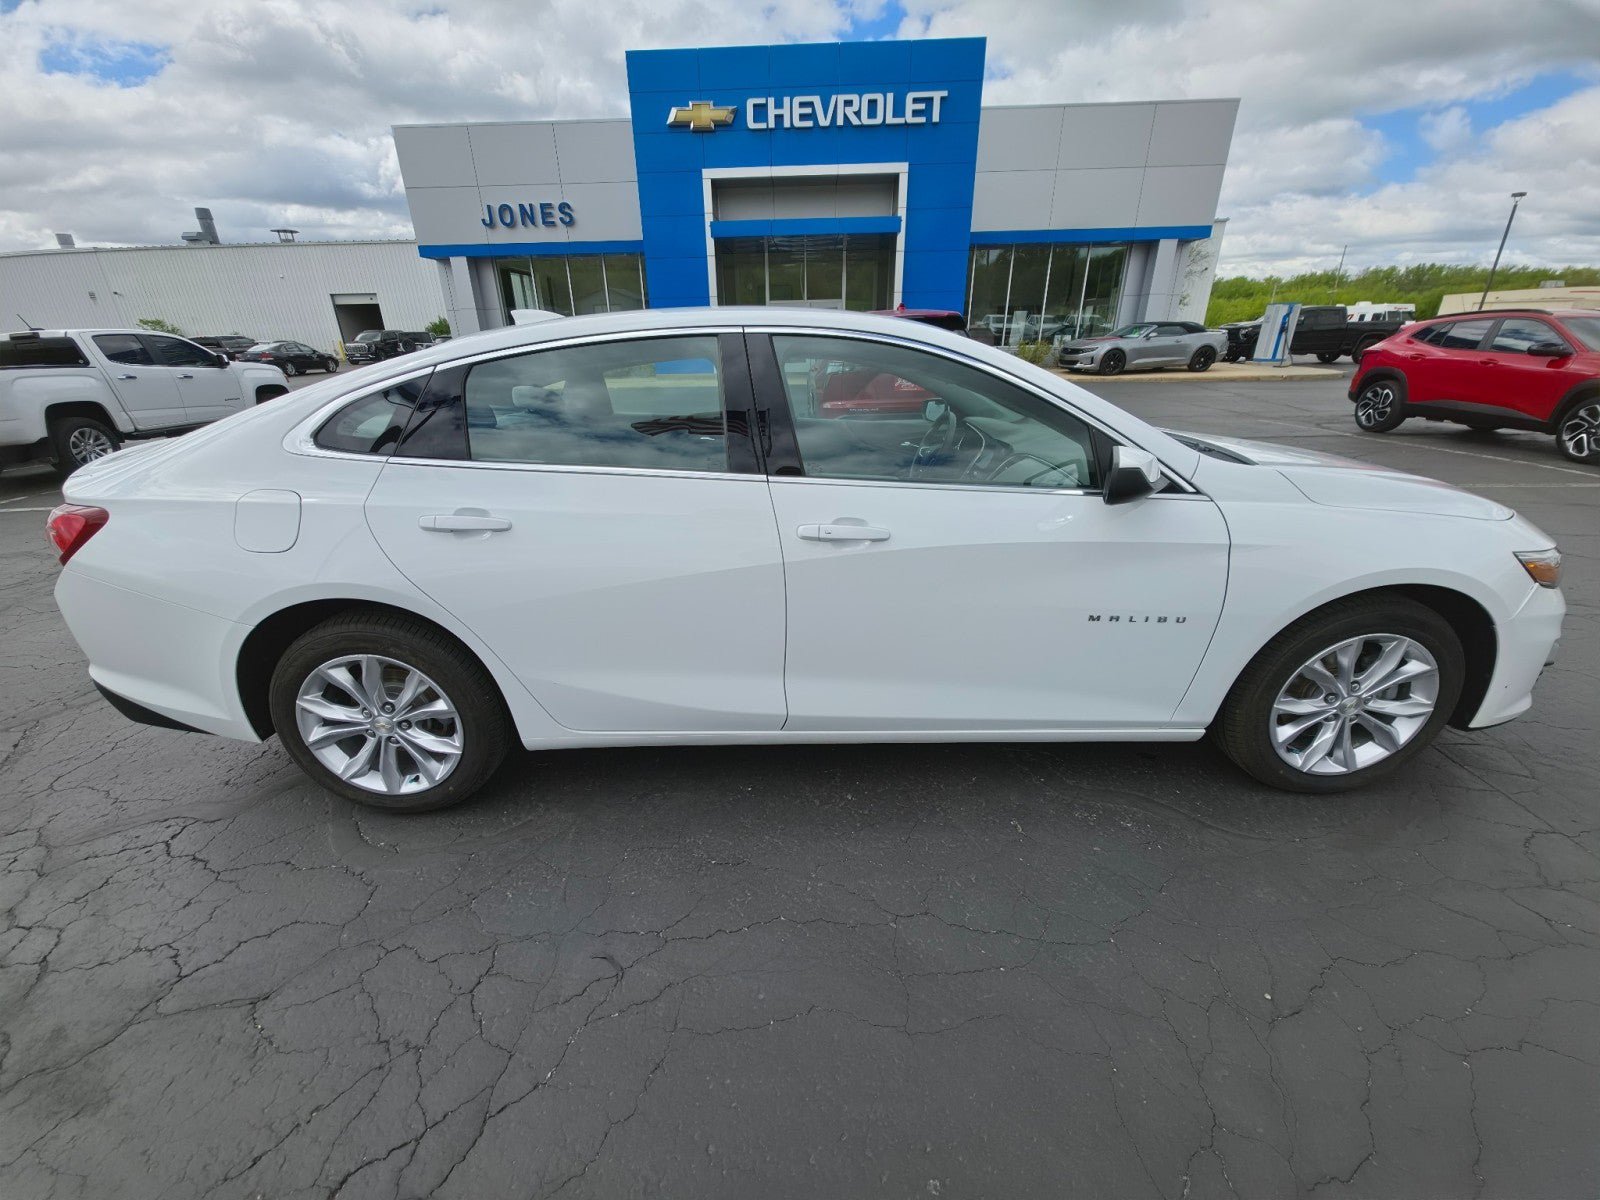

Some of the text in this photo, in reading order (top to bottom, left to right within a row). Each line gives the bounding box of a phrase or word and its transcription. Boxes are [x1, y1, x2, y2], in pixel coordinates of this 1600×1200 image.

[746, 90, 949, 129] CHEVROLET
[481, 202, 575, 228] JONES
[1088, 614, 1187, 624] MALIBU
